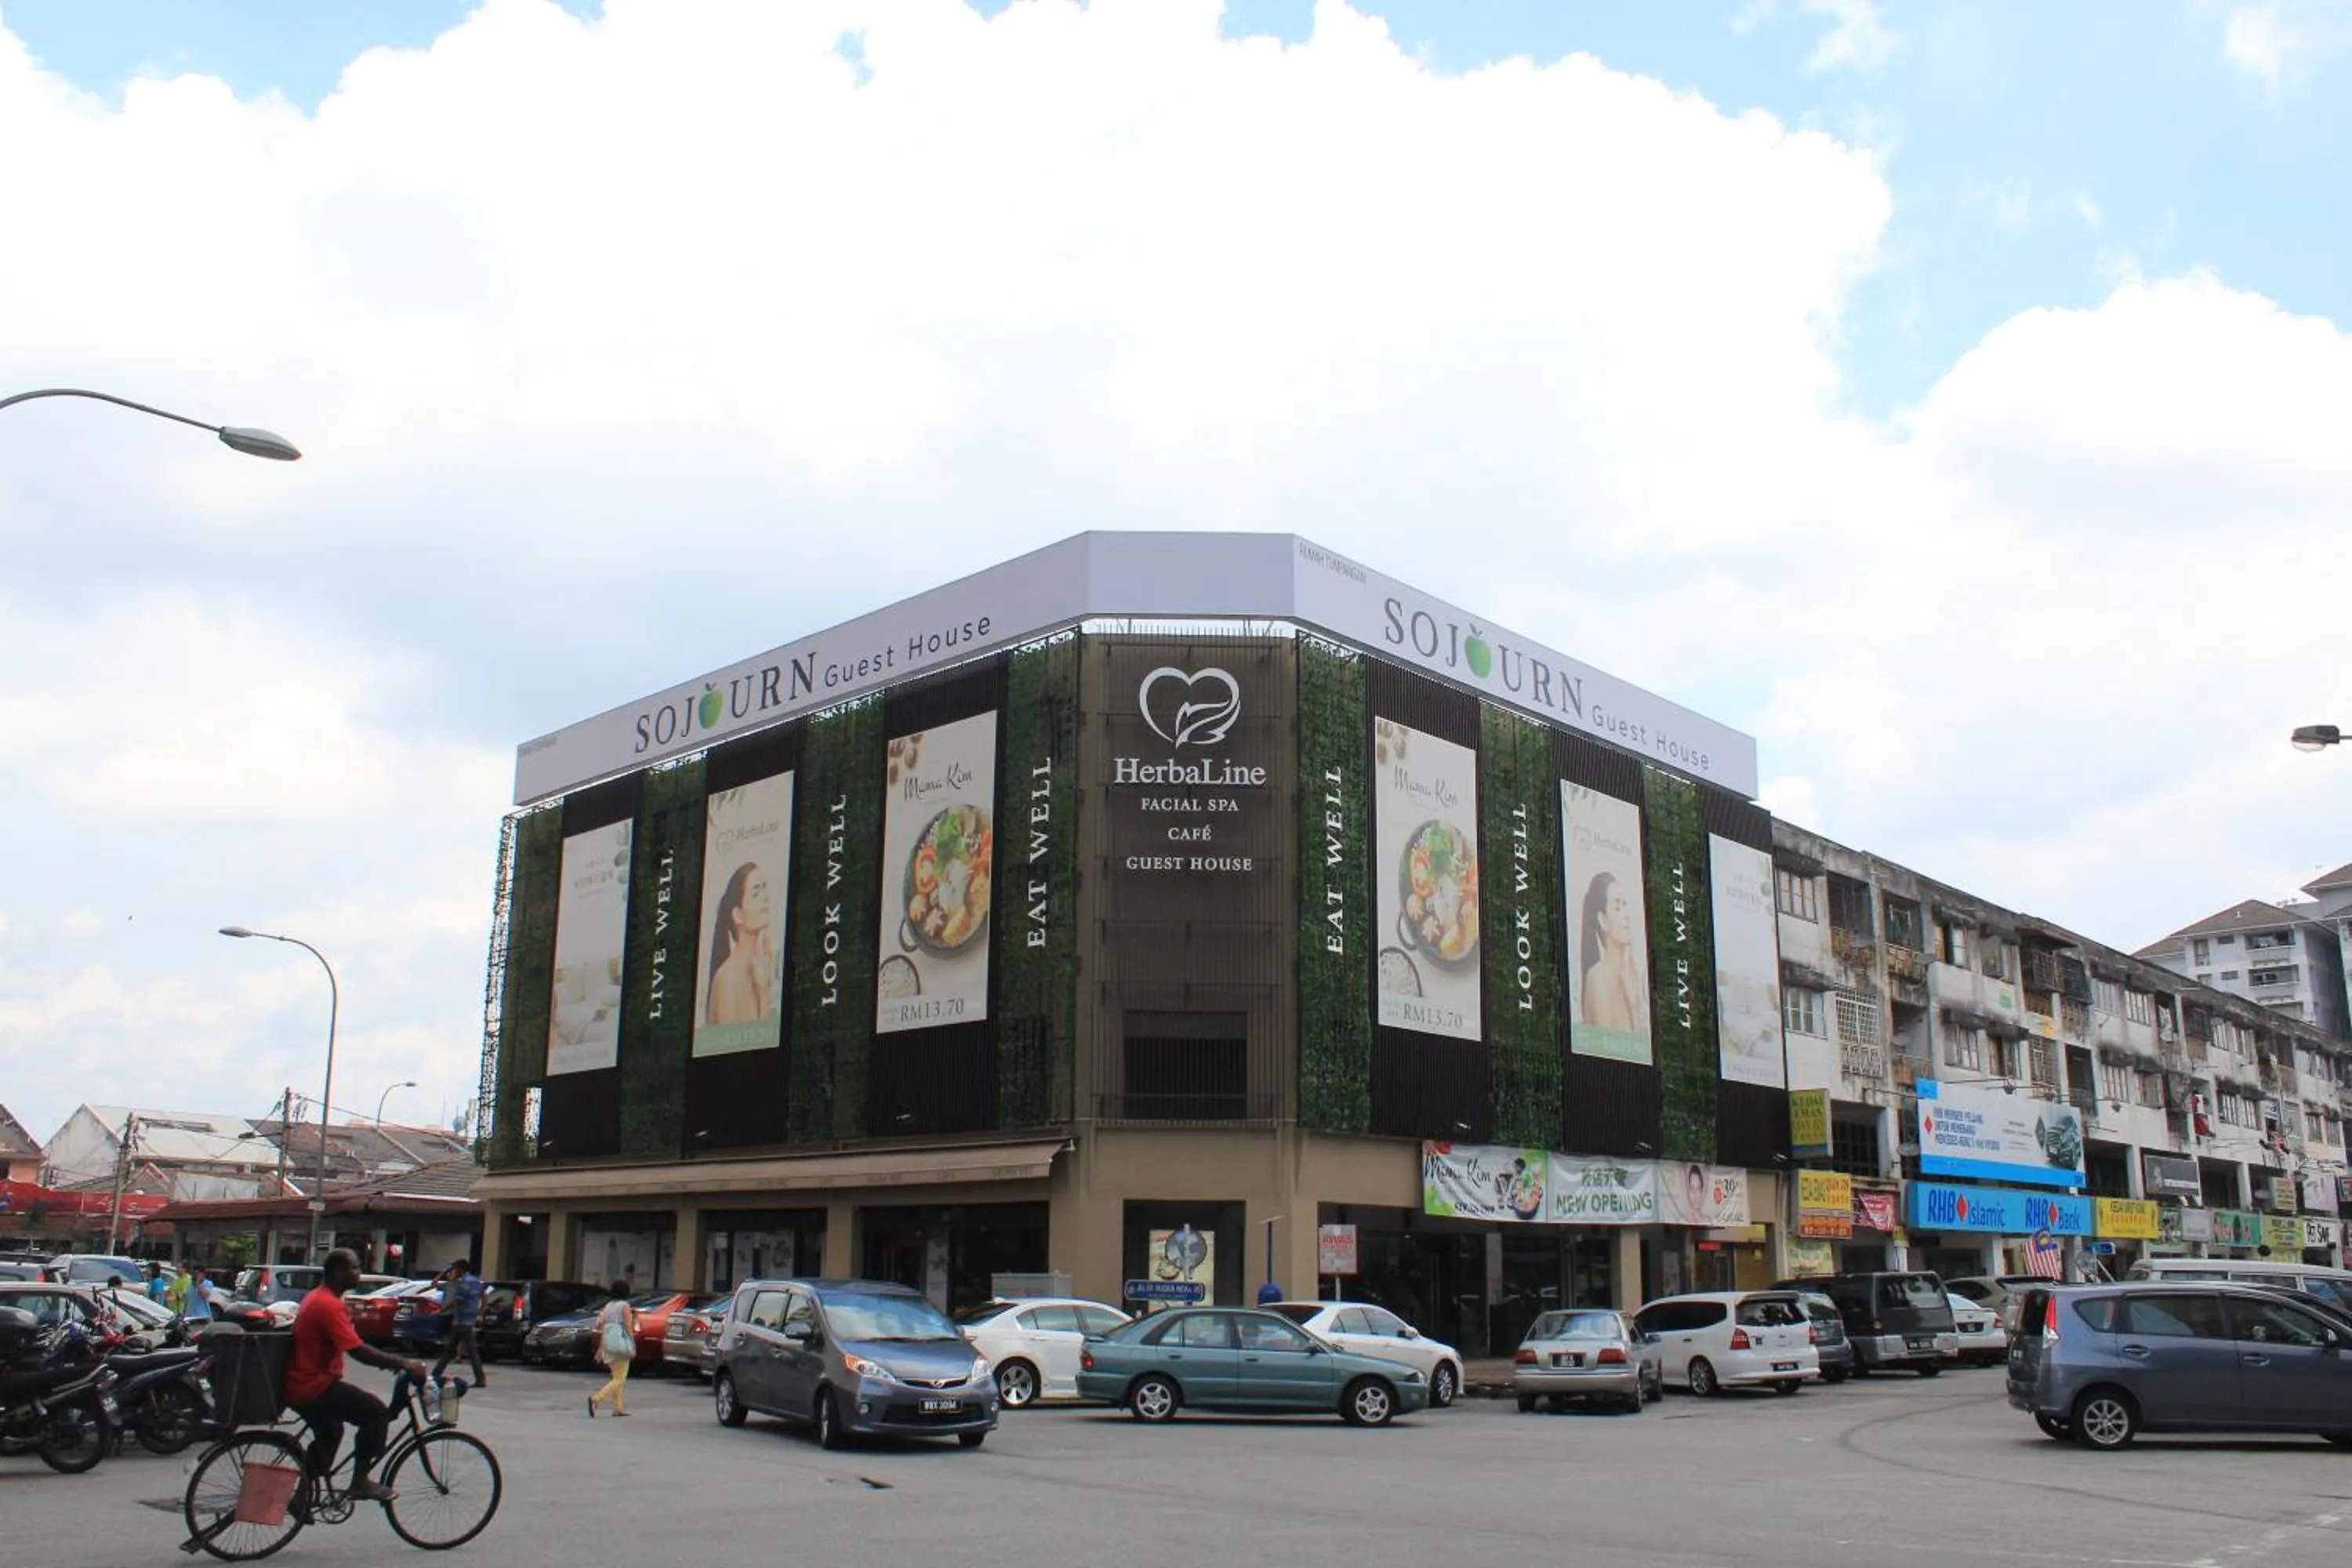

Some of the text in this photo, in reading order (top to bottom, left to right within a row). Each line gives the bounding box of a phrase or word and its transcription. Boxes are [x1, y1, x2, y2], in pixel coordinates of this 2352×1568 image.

[825, 646, 894, 688] Guest
[909, 616, 990, 660] House
[1592, 705, 1648, 746] Guest
[1656, 734, 1709, 771] House
[947, 761, 973, 790] Kim
[1113, 758, 1266, 785] HerbaLine
[1142, 798, 1239, 811] FACIAL SPA
[1027, 757, 1051, 948] EAT WELL
[1127, 856, 1252, 871] GUEST HOUSE
[1168, 824, 1211, 840] CAFÉ
[1325, 766, 1343, 956] EAT WELL
[822, 794, 847, 1006] LOOK WELL
[1513, 803, 1533, 1011] LOOK WELL
[1672, 862, 1691, 1029] LIVE WELL
[649, 949, 666, 1020] LIVE
[1556, 1192, 1653, 1214] NEW OPENING
[1928, 1189, 1955, 1224] RHB
[1967, 1200, 2006, 1228] Islamic
[2025, 1197, 2048, 1230] RHB
[2058, 1207, 2082, 1230] Bank
